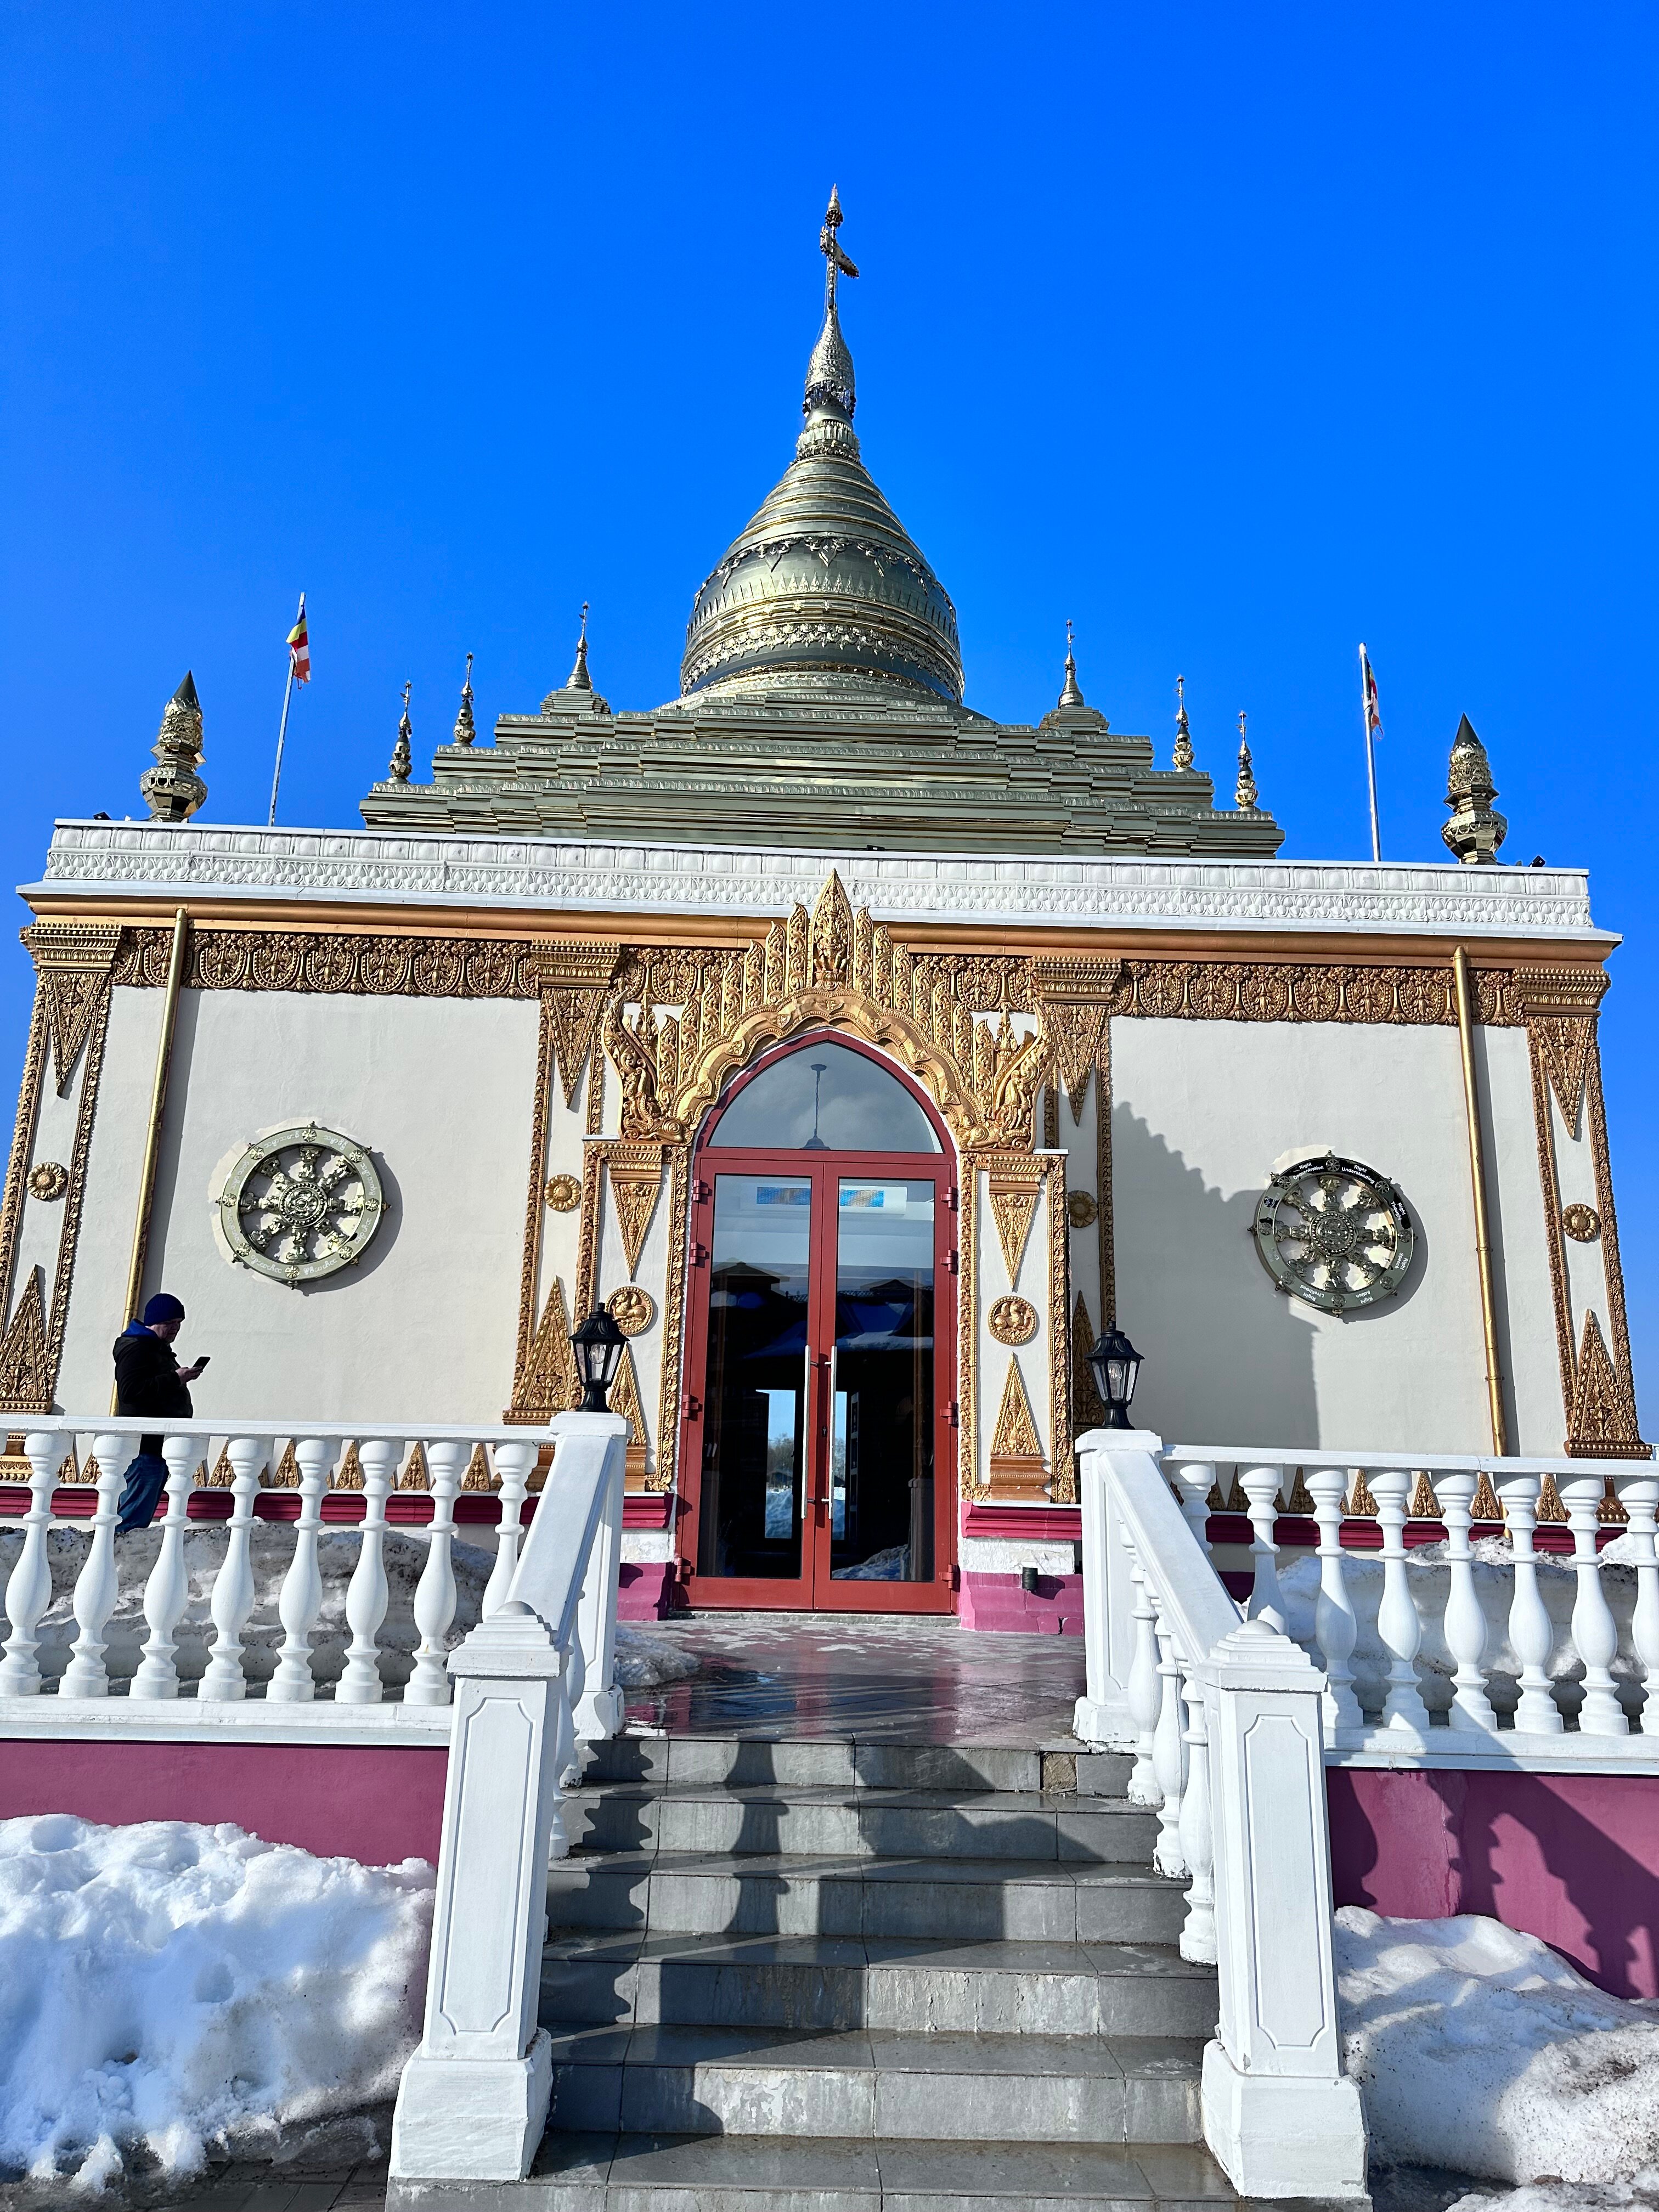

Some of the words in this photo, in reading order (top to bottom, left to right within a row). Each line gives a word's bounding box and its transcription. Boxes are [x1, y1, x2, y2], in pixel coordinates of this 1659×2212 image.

[1293, 1166, 1324, 1180] Concentration
[1342, 1167, 1375, 1184] Understanding
[1354, 1165, 1367, 1173] Right
[1391, 1201, 1402, 1221] Thought
[1397, 1203, 1406, 1215] Right
[1394, 1252, 1404, 1269] Speech
[1400, 1257, 1408, 1271] Right
[1300, 1284, 1324, 1298] Livelihood
[1303, 1292, 1316, 1301] Right
[1356, 1290, 1370, 1298] Action
